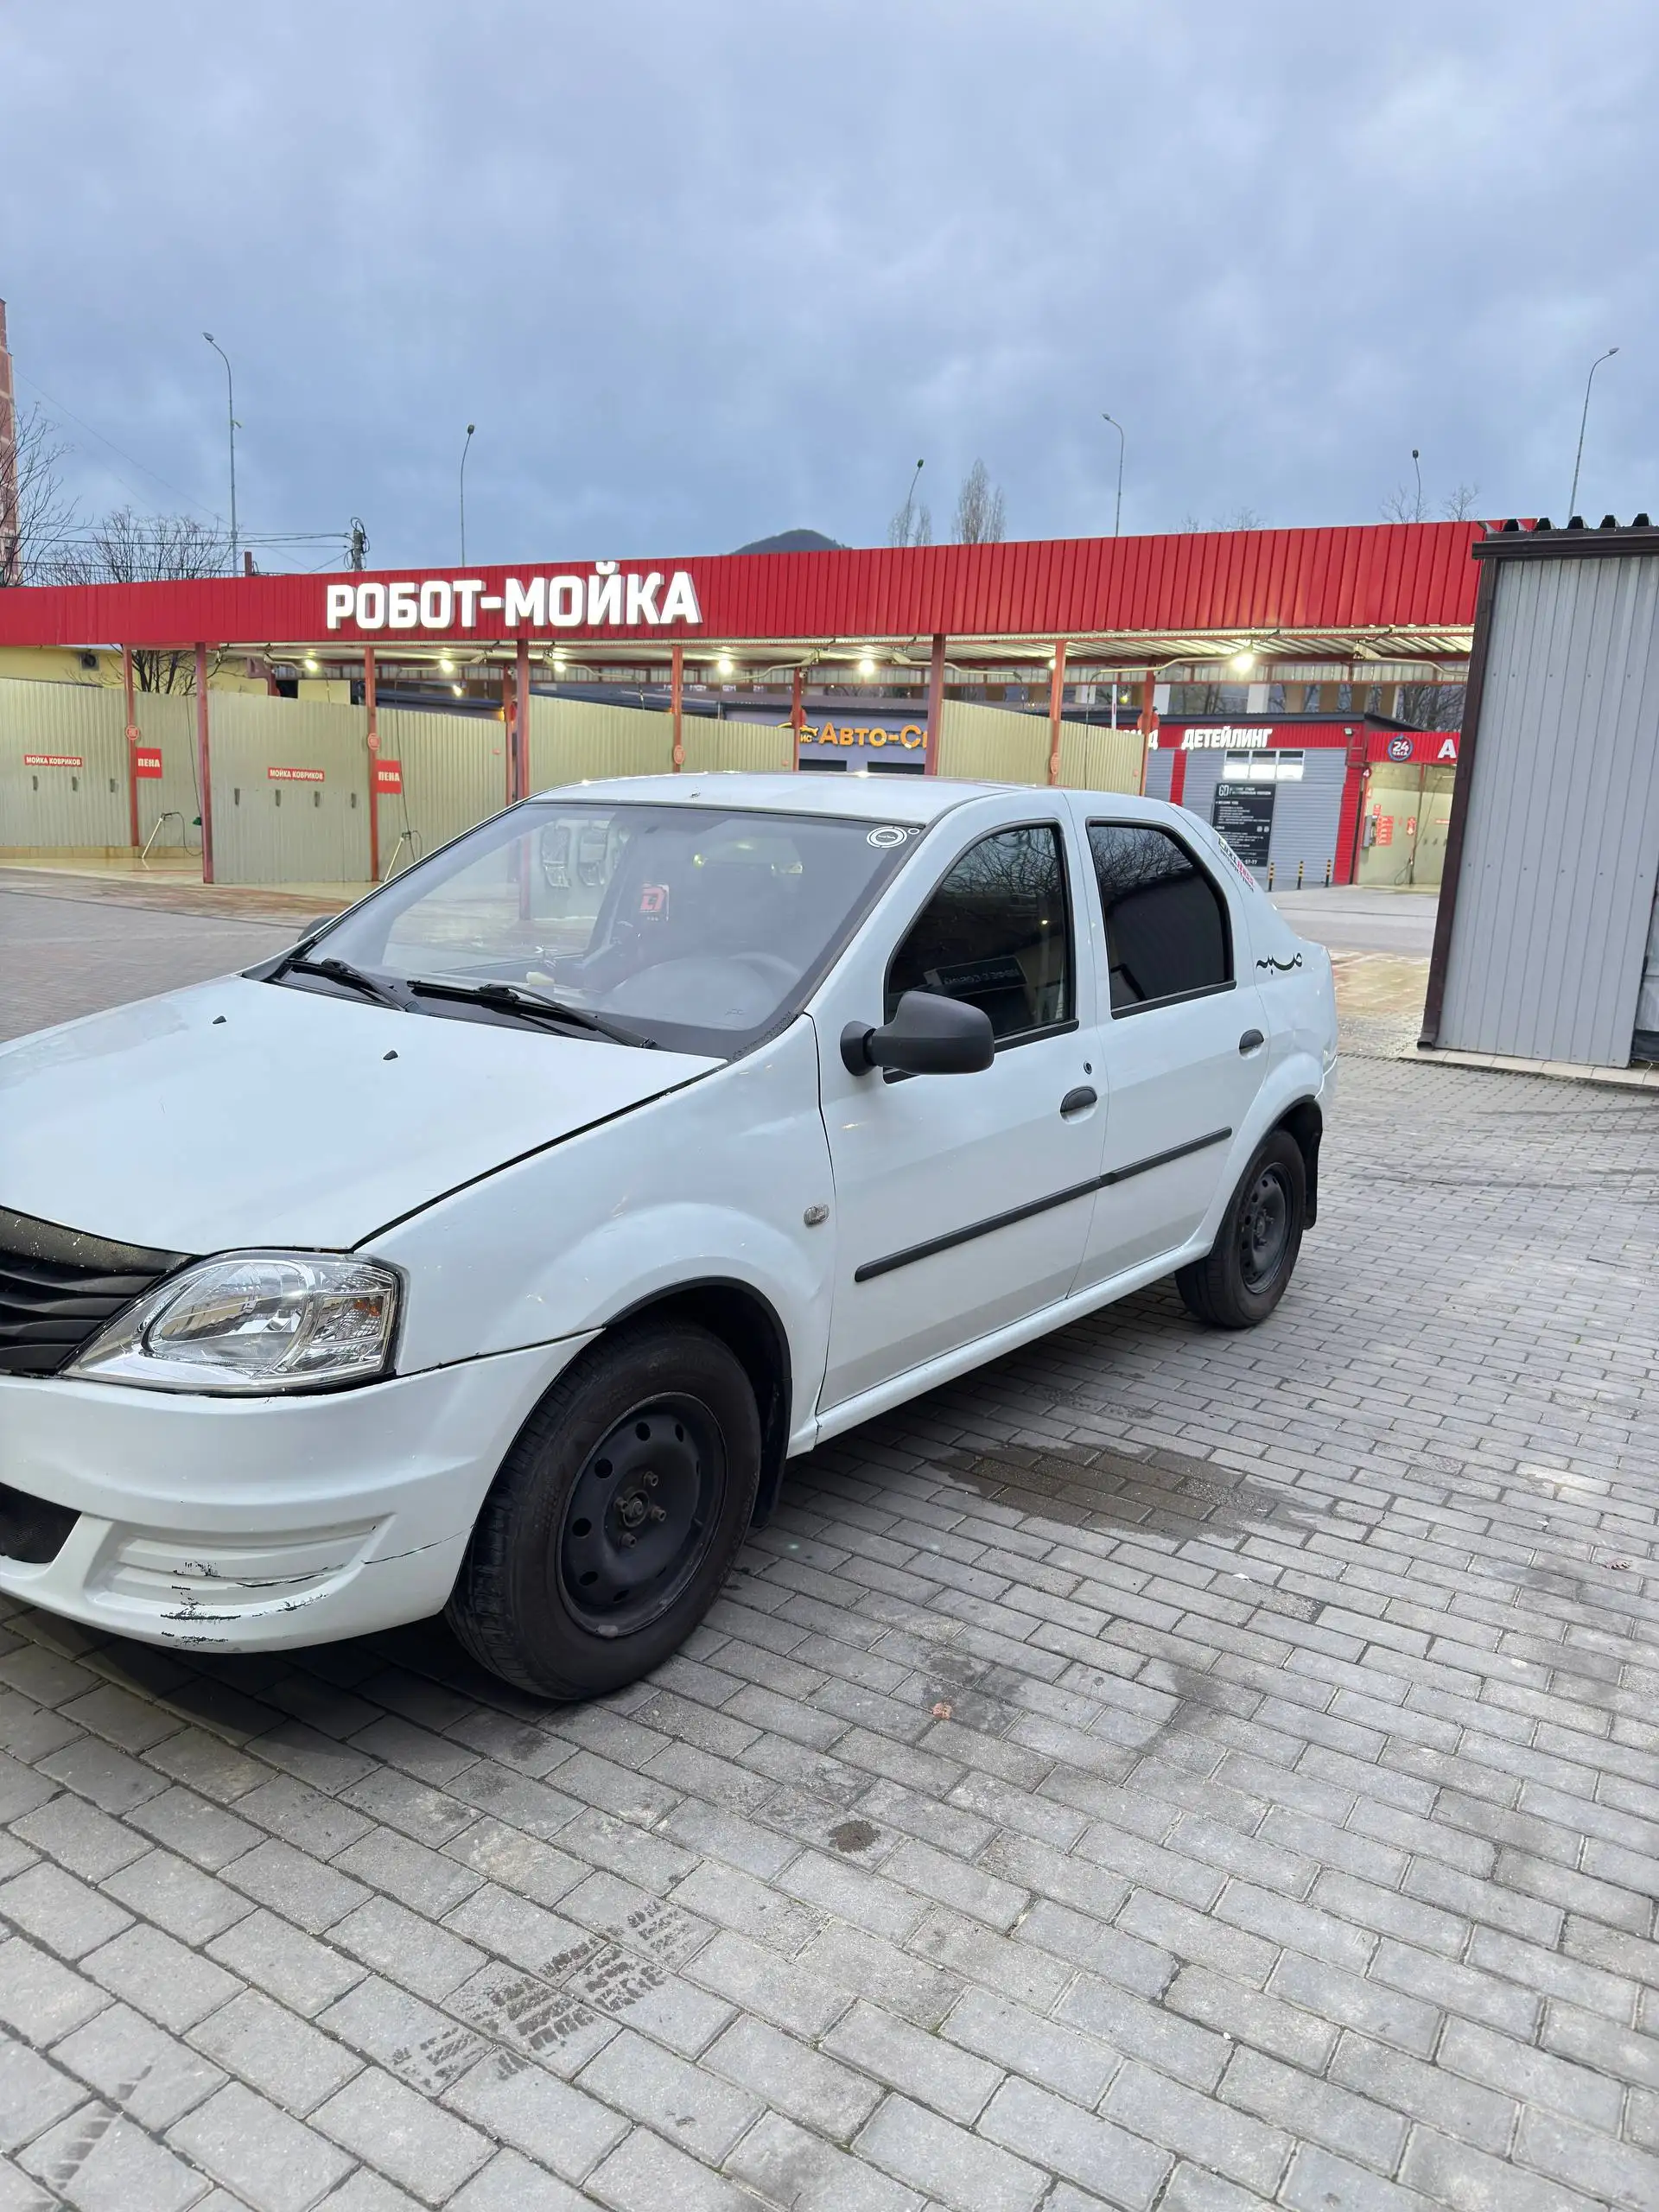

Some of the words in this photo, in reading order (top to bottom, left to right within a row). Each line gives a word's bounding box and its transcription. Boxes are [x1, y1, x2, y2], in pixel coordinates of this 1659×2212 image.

[327, 561, 702, 629] РОБОТ-МОЙКА
[1181, 726, 1273, 750] ДЕТЕЙЛИНГ
[1392, 741, 1409, 753] 24
[26, 756, 48, 765] МОЙКА
[48, 757, 81, 766] КОВРИКОВ
[137, 758, 161, 768] ПЕНА
[270, 769, 291, 778] МОЙКА
[292, 770, 323, 779] КОВРИКОВ
[378, 771, 400, 782] ПЕНА
